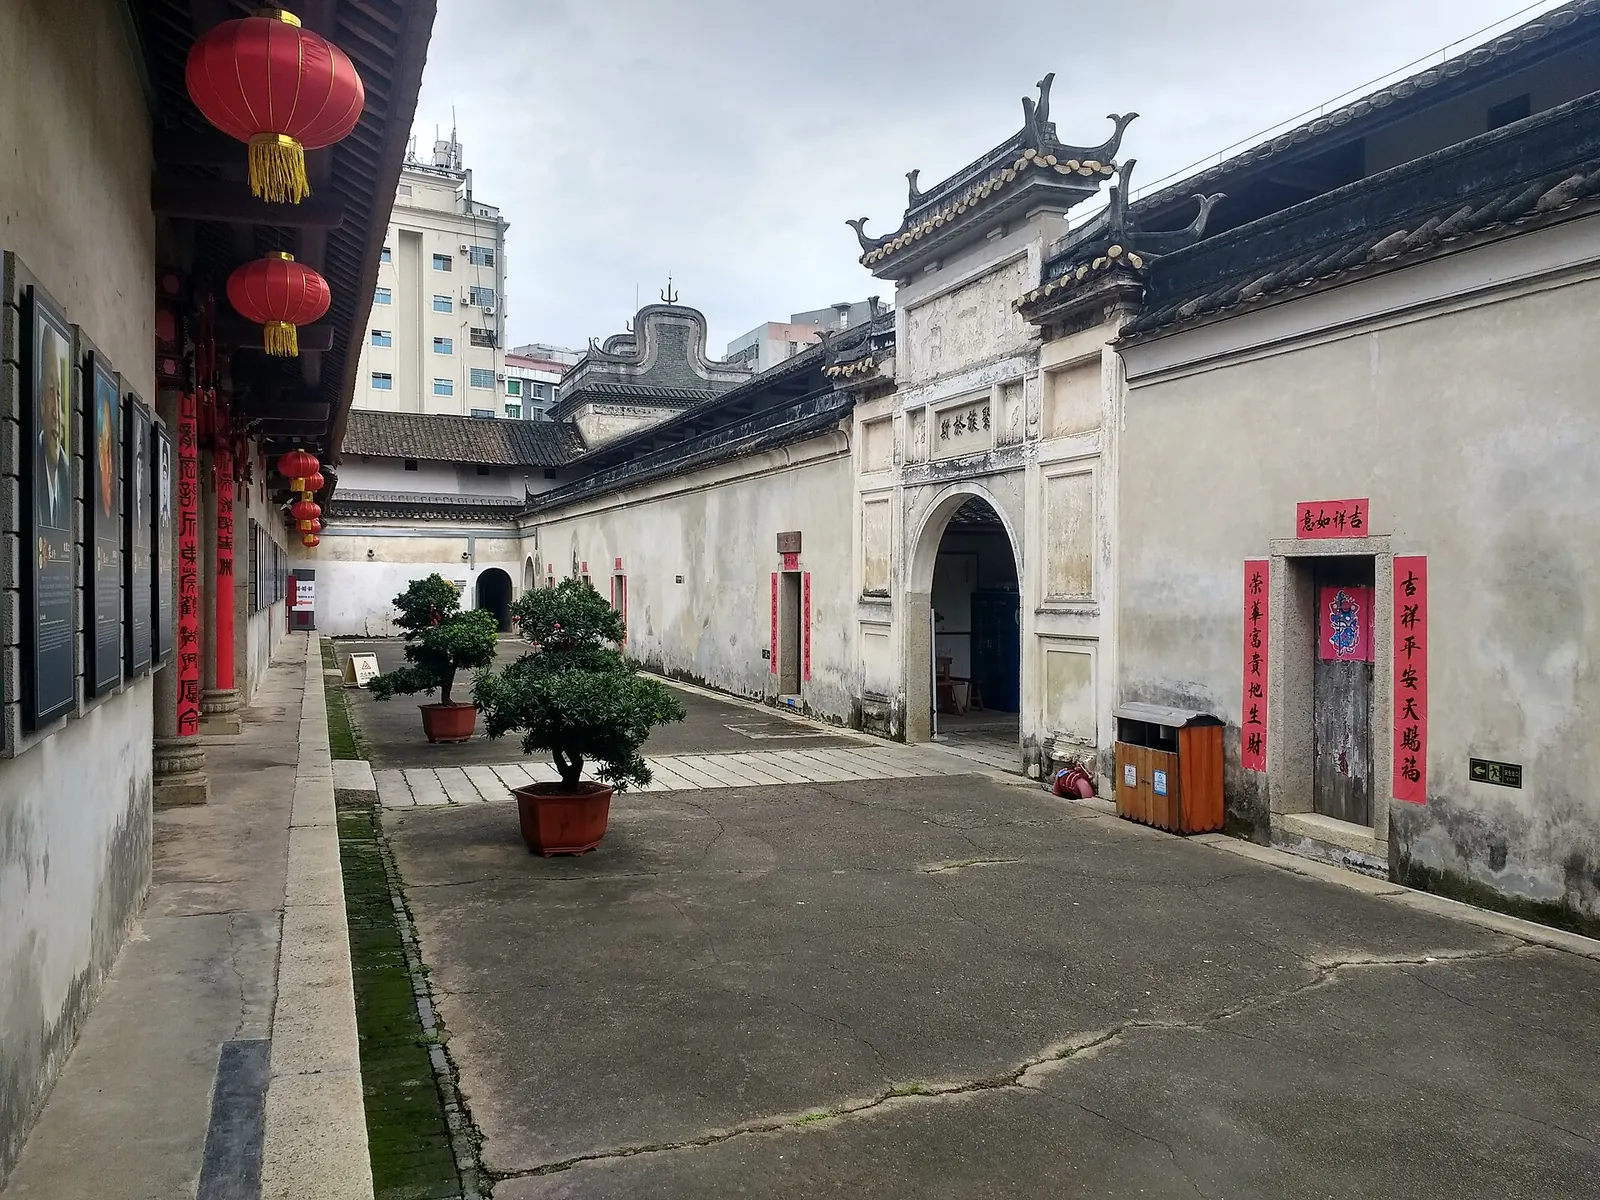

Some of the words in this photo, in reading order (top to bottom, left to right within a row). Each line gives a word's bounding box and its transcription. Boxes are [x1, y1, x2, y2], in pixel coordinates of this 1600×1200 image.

[1300, 505, 1362, 532] 吉祥如意
[1399, 571, 1421, 783] 吉祥平安天賜福
